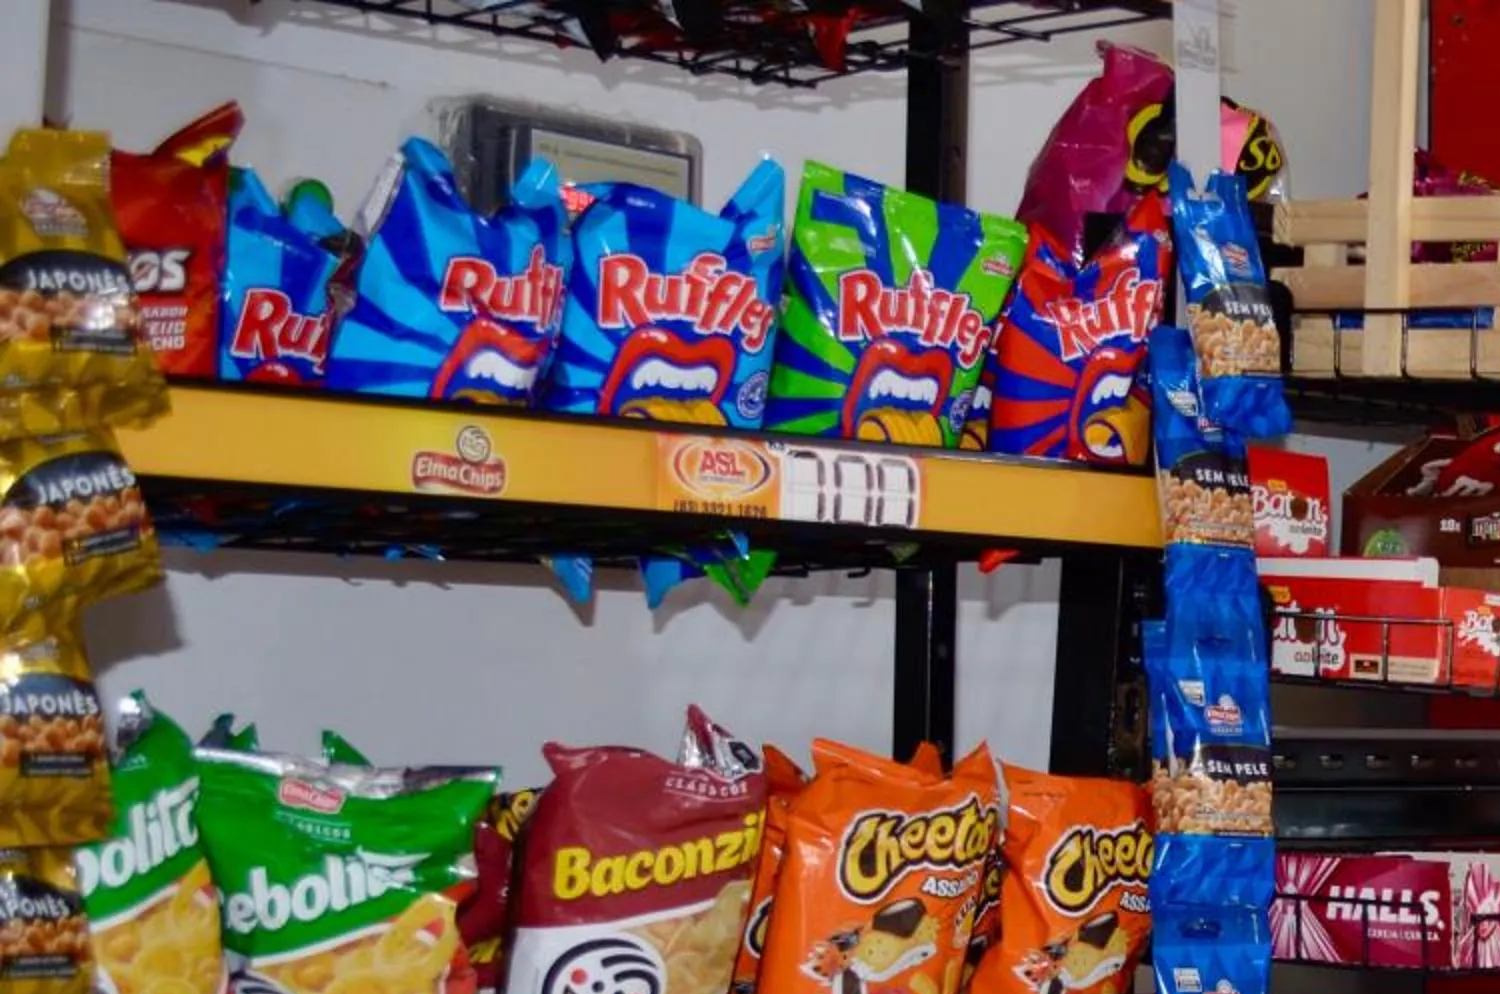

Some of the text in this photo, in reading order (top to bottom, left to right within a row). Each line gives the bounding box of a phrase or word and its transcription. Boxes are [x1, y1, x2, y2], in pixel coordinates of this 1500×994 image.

[600, 253, 773, 350] Ruffles
[839, 268, 990, 368] Ruffles
[700, 451, 744, 477] ASL
[1195, 468, 1225, 483] SEM
[35, 466, 135, 506] JAPONÊS
[0, 689, 98, 716] JAPONÊS
[1234, 762, 1269, 775] PELE
[840, 794, 998, 902] Cheetos
